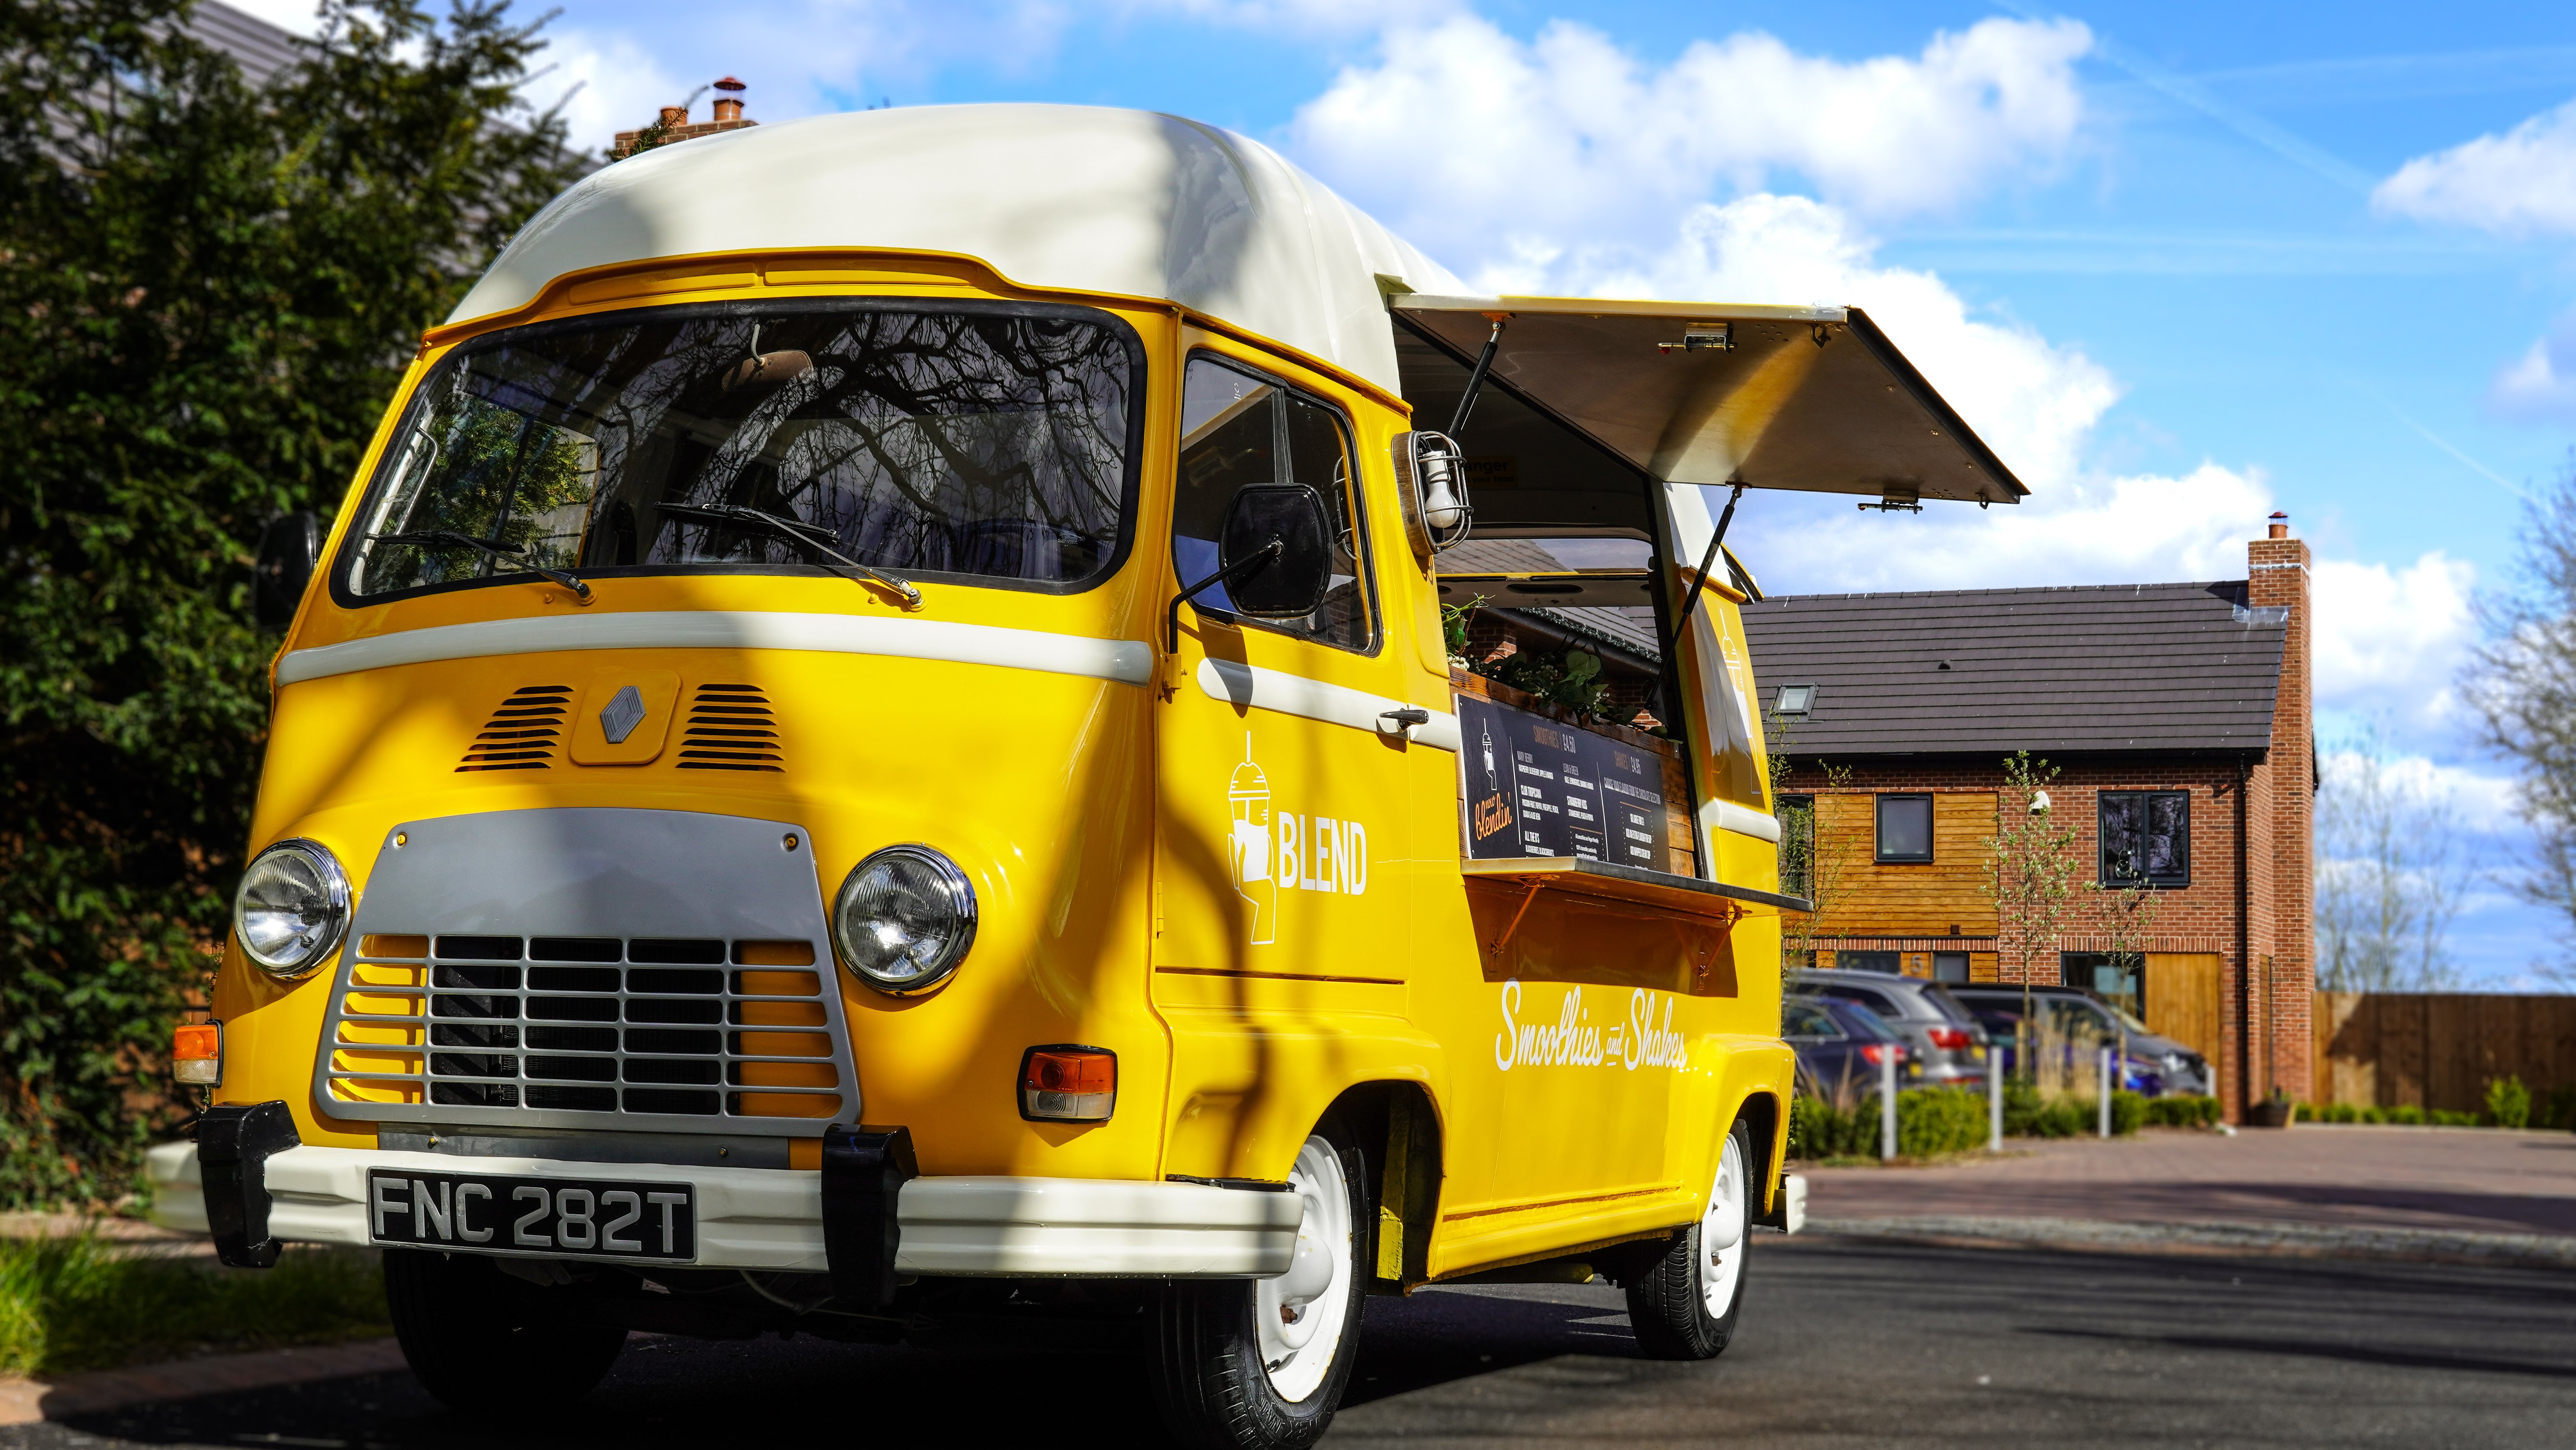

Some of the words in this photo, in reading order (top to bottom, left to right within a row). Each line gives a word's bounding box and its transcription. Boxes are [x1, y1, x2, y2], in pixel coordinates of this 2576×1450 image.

[1464, 461, 1508, 474] anger
[1533, 724, 1559, 748] SMOOTHIES
[1562, 733, 1576, 754] £4.50
[1516, 750, 1525, 762] MARY
[1525, 752, 1533, 764] BERRY
[1630, 755, 1641, 775] £4.95
[1485, 795, 1495, 810] now
[1475, 791, 1512, 841] blendin'
[1278, 811, 1367, 895] BLEND
[1911, 955, 1923, 973] 5
[1495, 977, 1604, 1071] Smoothies
[1606, 1021, 1625, 1056] and
[1624, 988, 1688, 1071] Shakes
[372, 1176, 494, 1242] FNC
[512, 1186, 687, 1253] 282T
